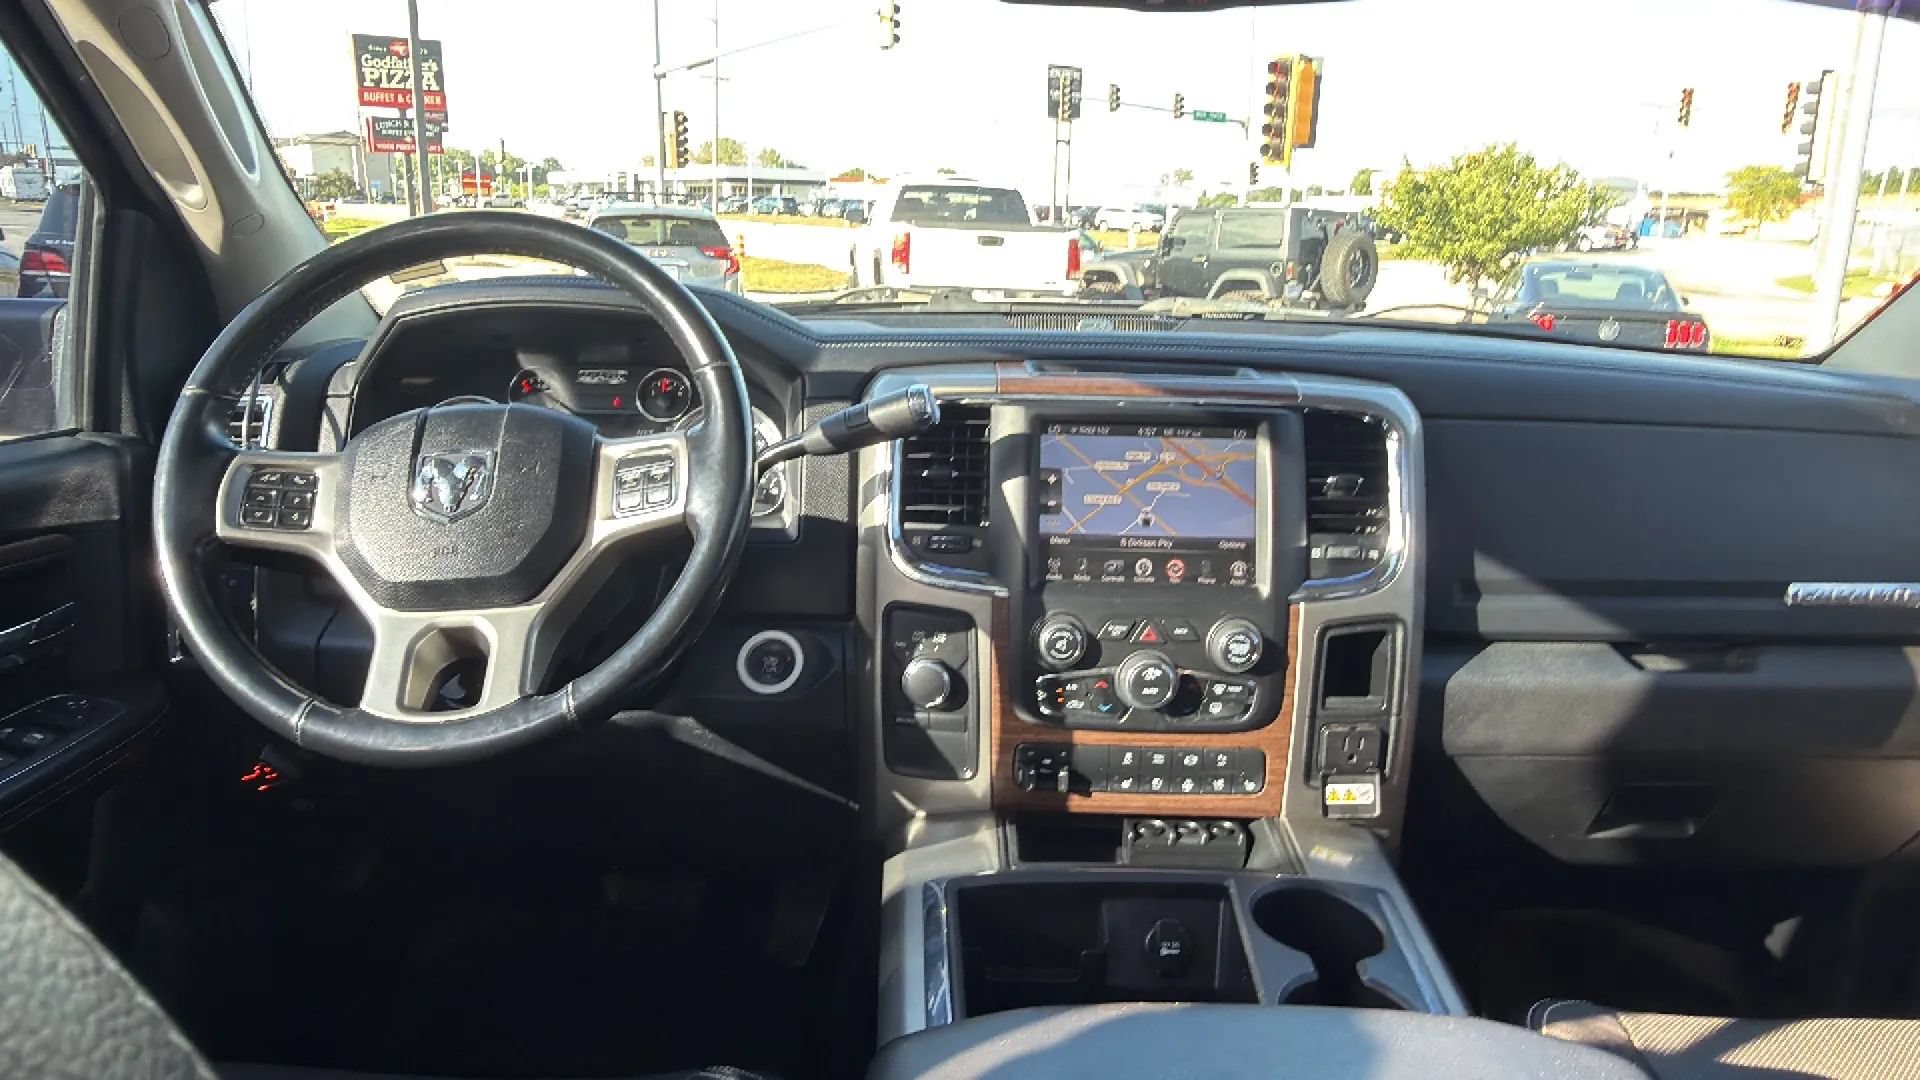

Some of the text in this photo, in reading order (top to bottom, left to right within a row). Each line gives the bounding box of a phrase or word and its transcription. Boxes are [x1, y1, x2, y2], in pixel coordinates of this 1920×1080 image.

[361, 53, 439, 72] Godfater's
[362, 67, 440, 91] PIZZA
[363, 91, 395, 103] BUFFET
[406, 93, 441, 105] CKEN
